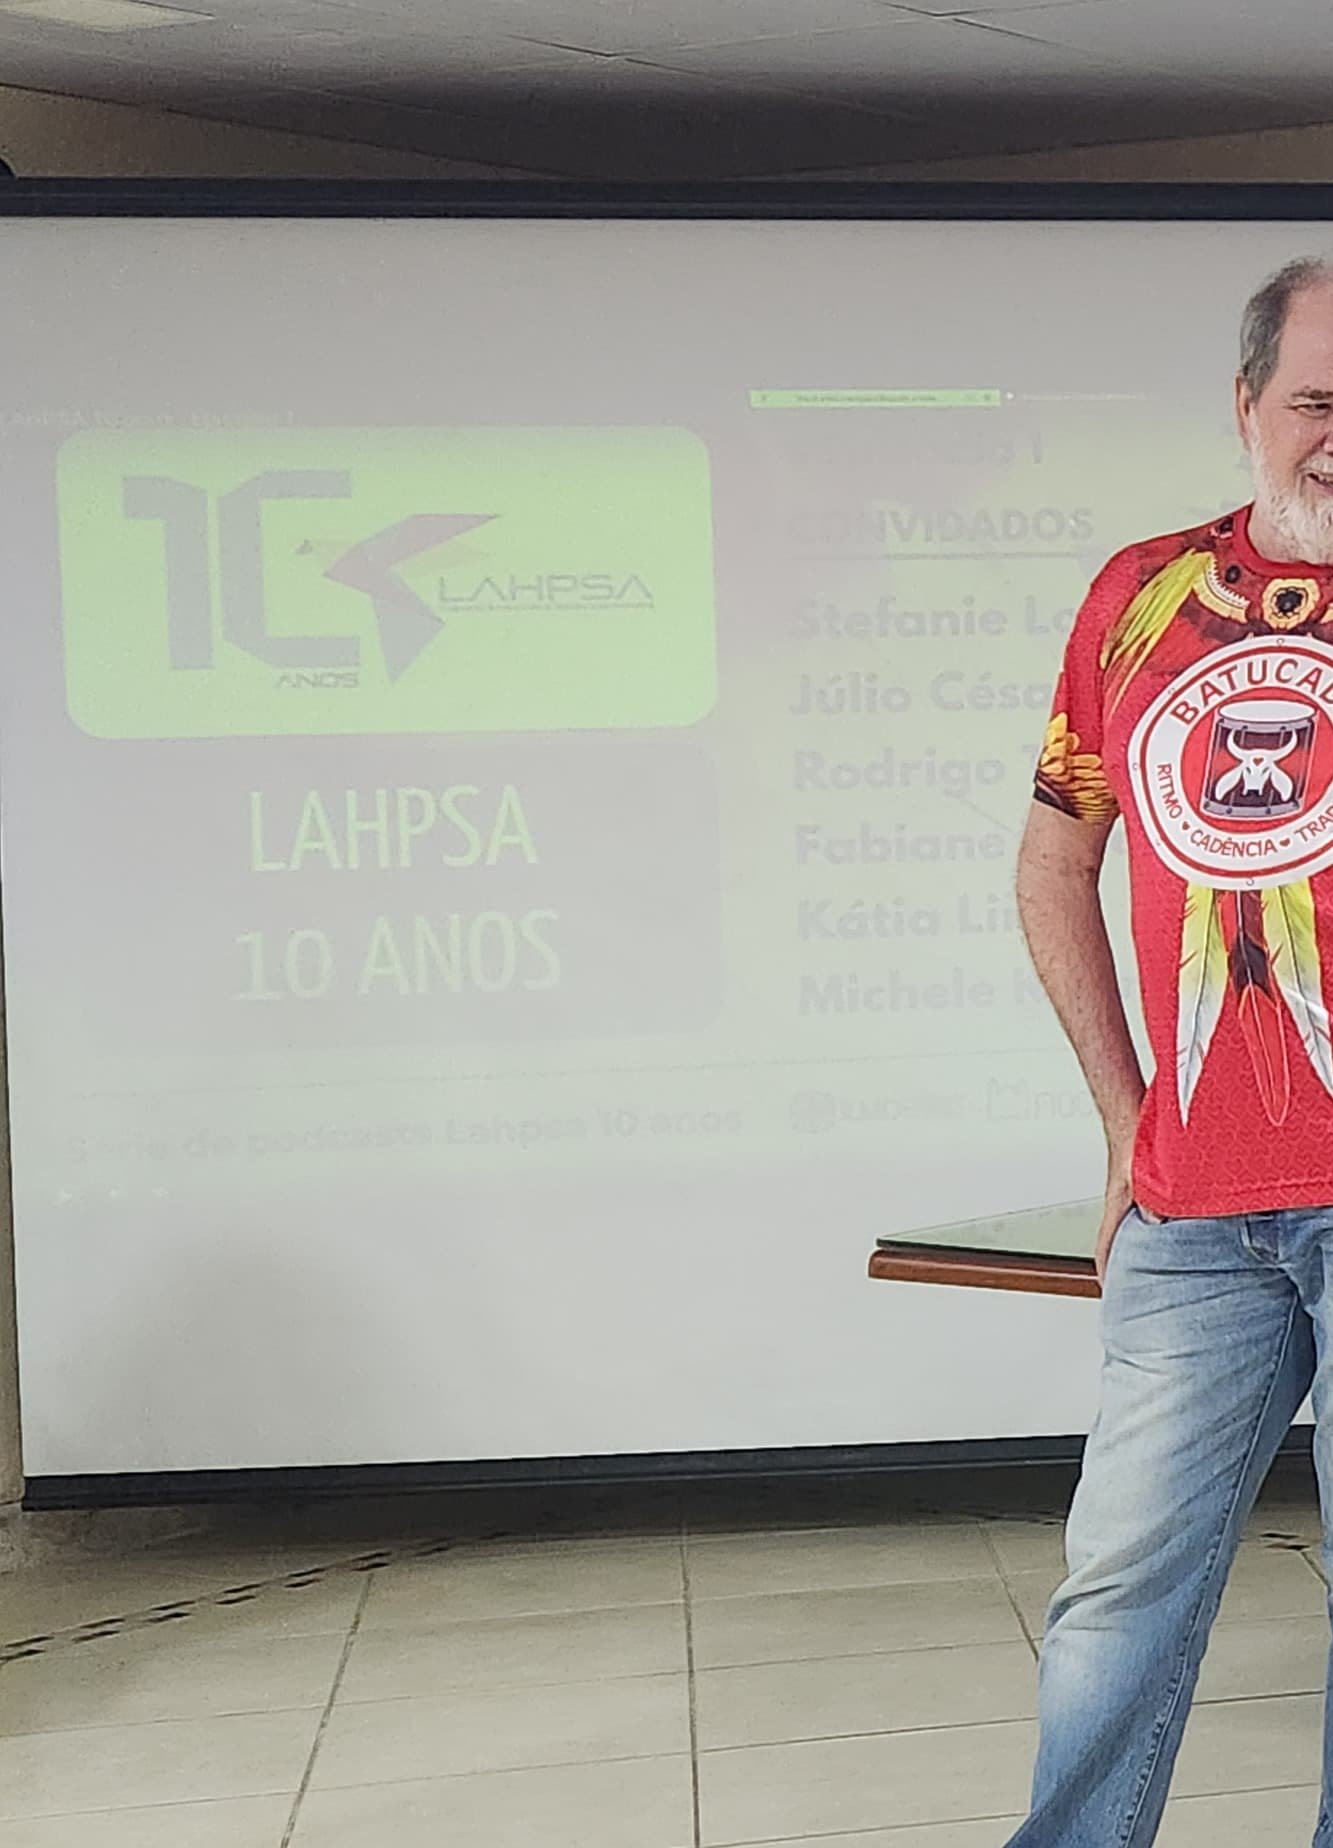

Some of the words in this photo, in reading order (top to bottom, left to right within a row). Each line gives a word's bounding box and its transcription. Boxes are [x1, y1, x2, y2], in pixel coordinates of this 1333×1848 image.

[788, 507, 1096, 545] CONVIDADOS
[439, 574, 654, 602] LAHPSA
[790, 595, 1008, 640] Stefanie
[274, 671, 360, 689] ANOS
[789, 671, 912, 716] Júlio
[793, 747, 1006, 799] Rodrigo
[249, 784, 540, 873] LAHPSA
[1156, 762, 1183, 820] RITMO
[1190, 829, 1278, 857] CADÊNCIA
[794, 821, 1005, 866] Fabiane
[797, 896, 941, 941] Kátia
[233, 929, 334, 1001] 10
[358, 909, 562, 996] ANOS
[797, 966, 995, 1017] Michele
